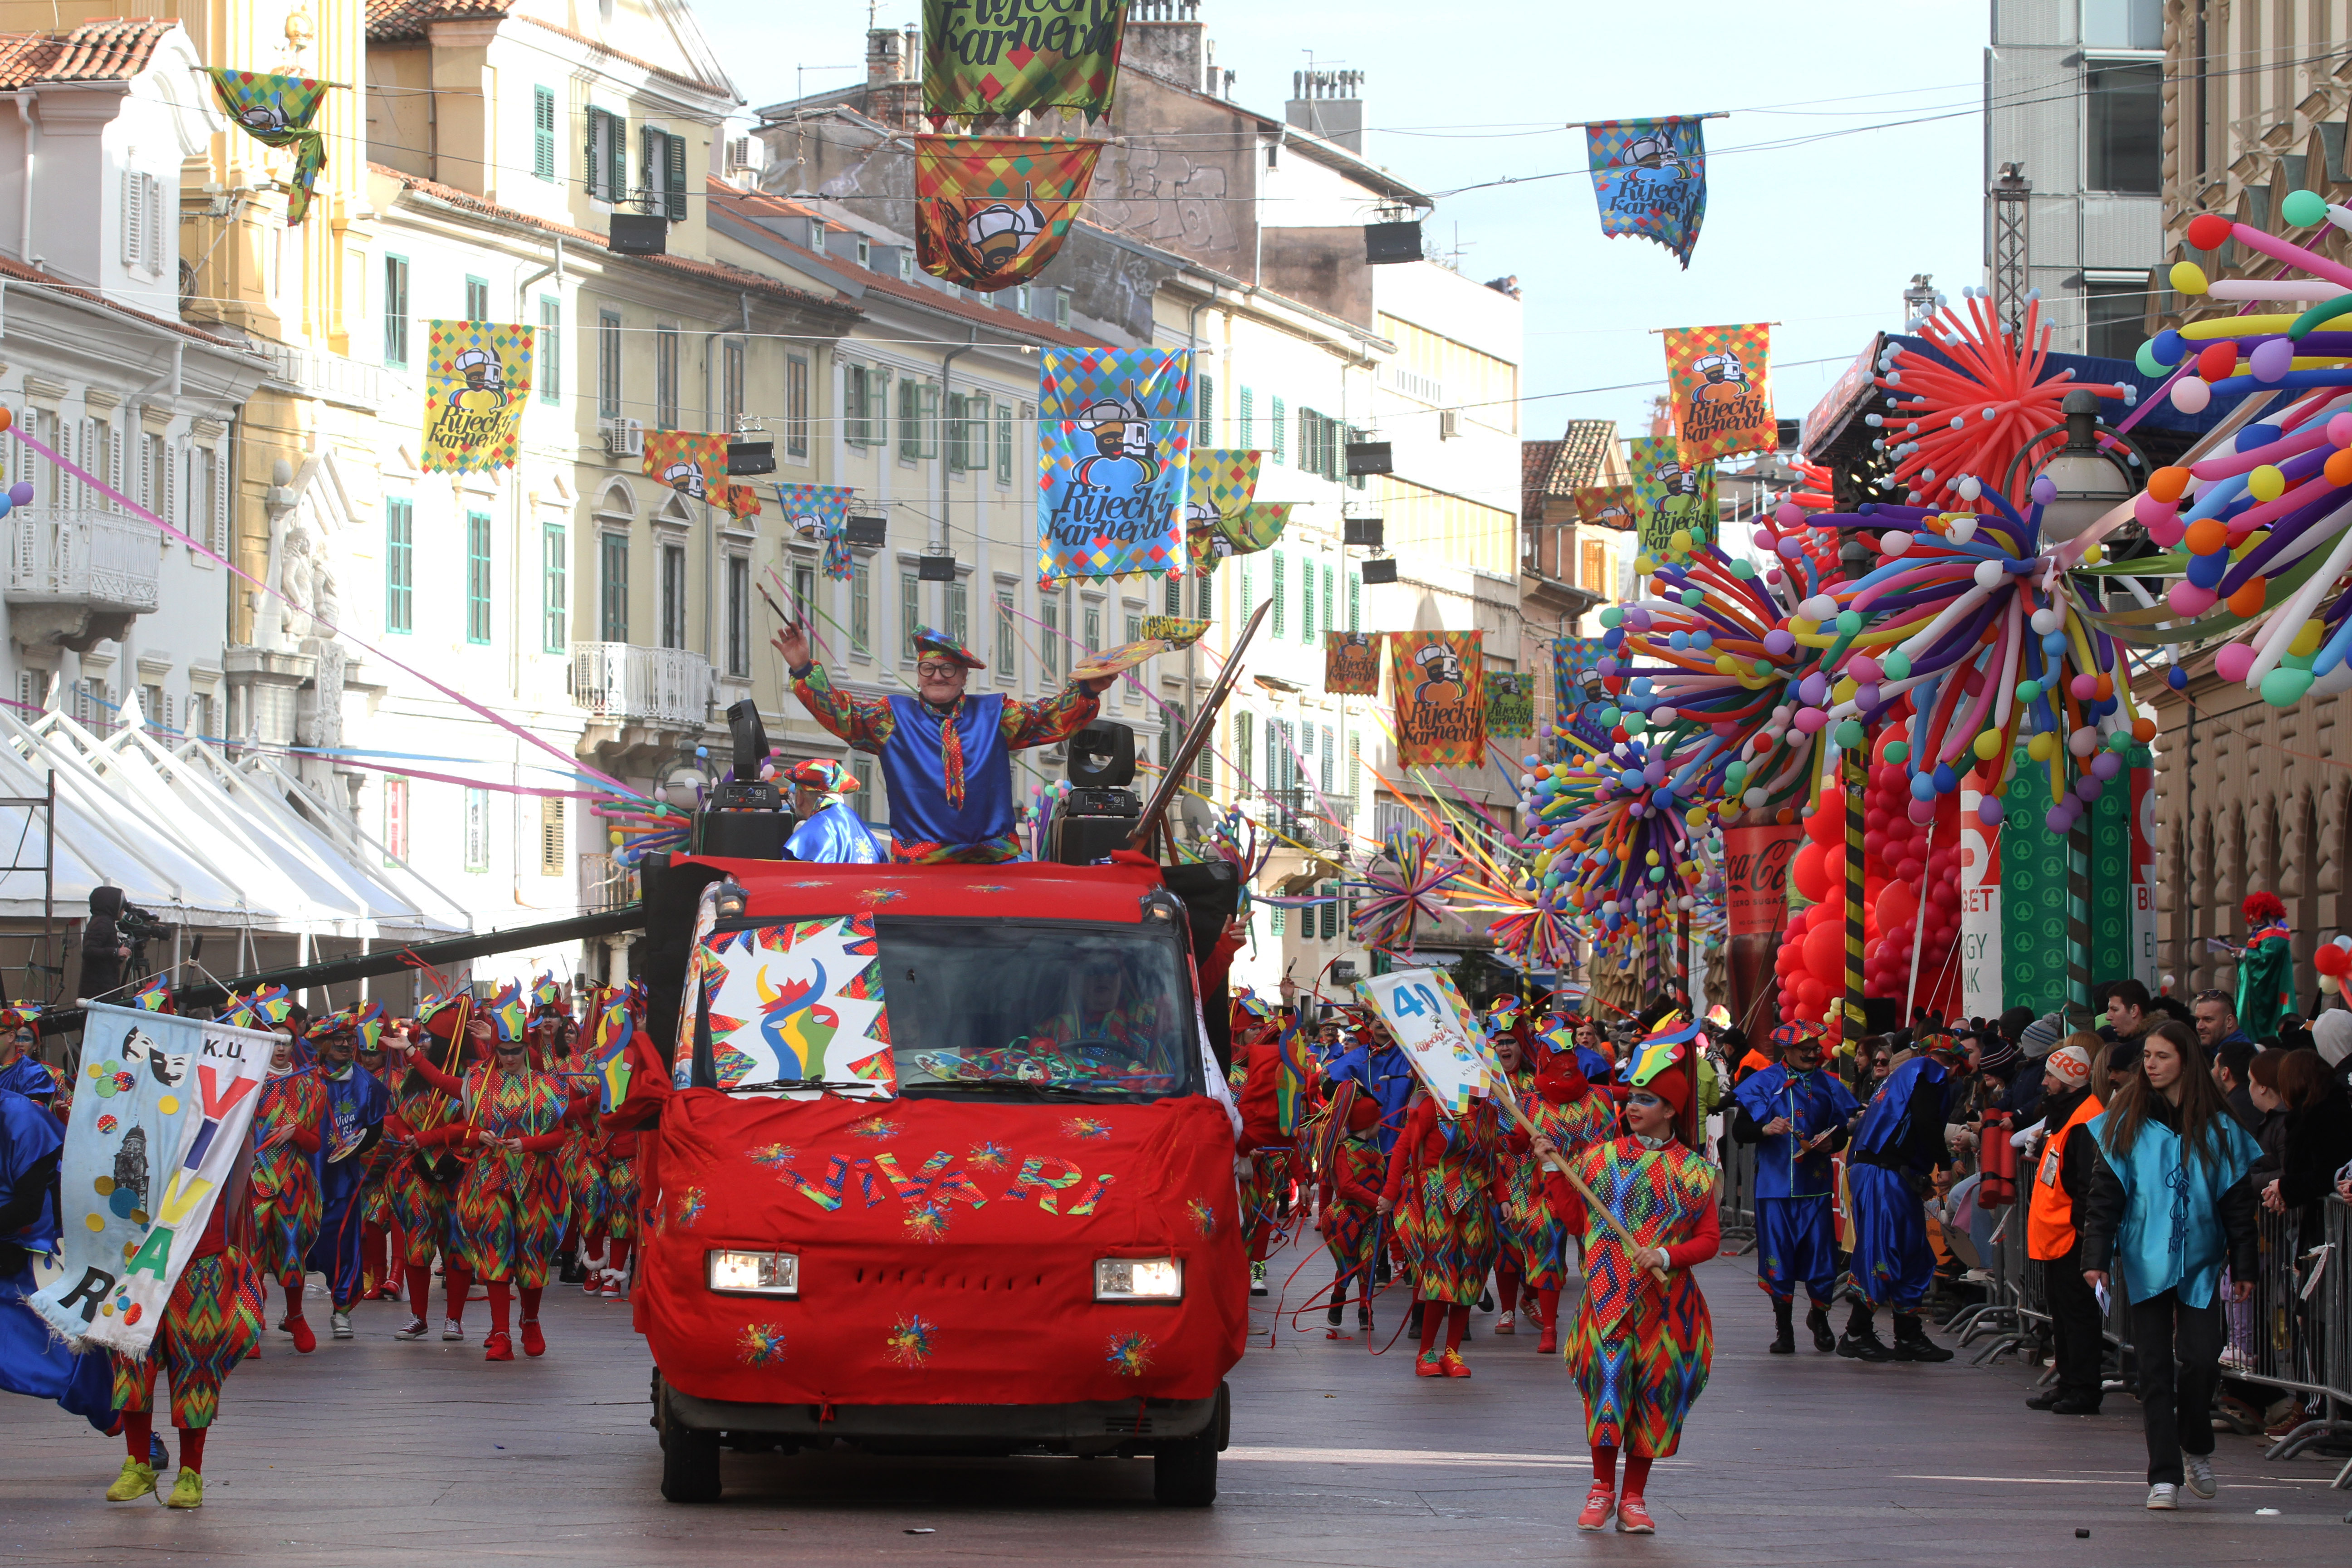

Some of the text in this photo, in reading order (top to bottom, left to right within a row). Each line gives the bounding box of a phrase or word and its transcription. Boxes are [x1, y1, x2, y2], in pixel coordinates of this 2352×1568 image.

[429, 421, 511, 449] karneval
[1682, 407, 1765, 442] karneval
[1046, 503, 1175, 546] karneval
[1403, 717, 1480, 745] karneval
[1393, 983, 1441, 1017] 40
[203, 1038, 247, 1063] K.U.
[336, 1114, 355, 1127] Viva
